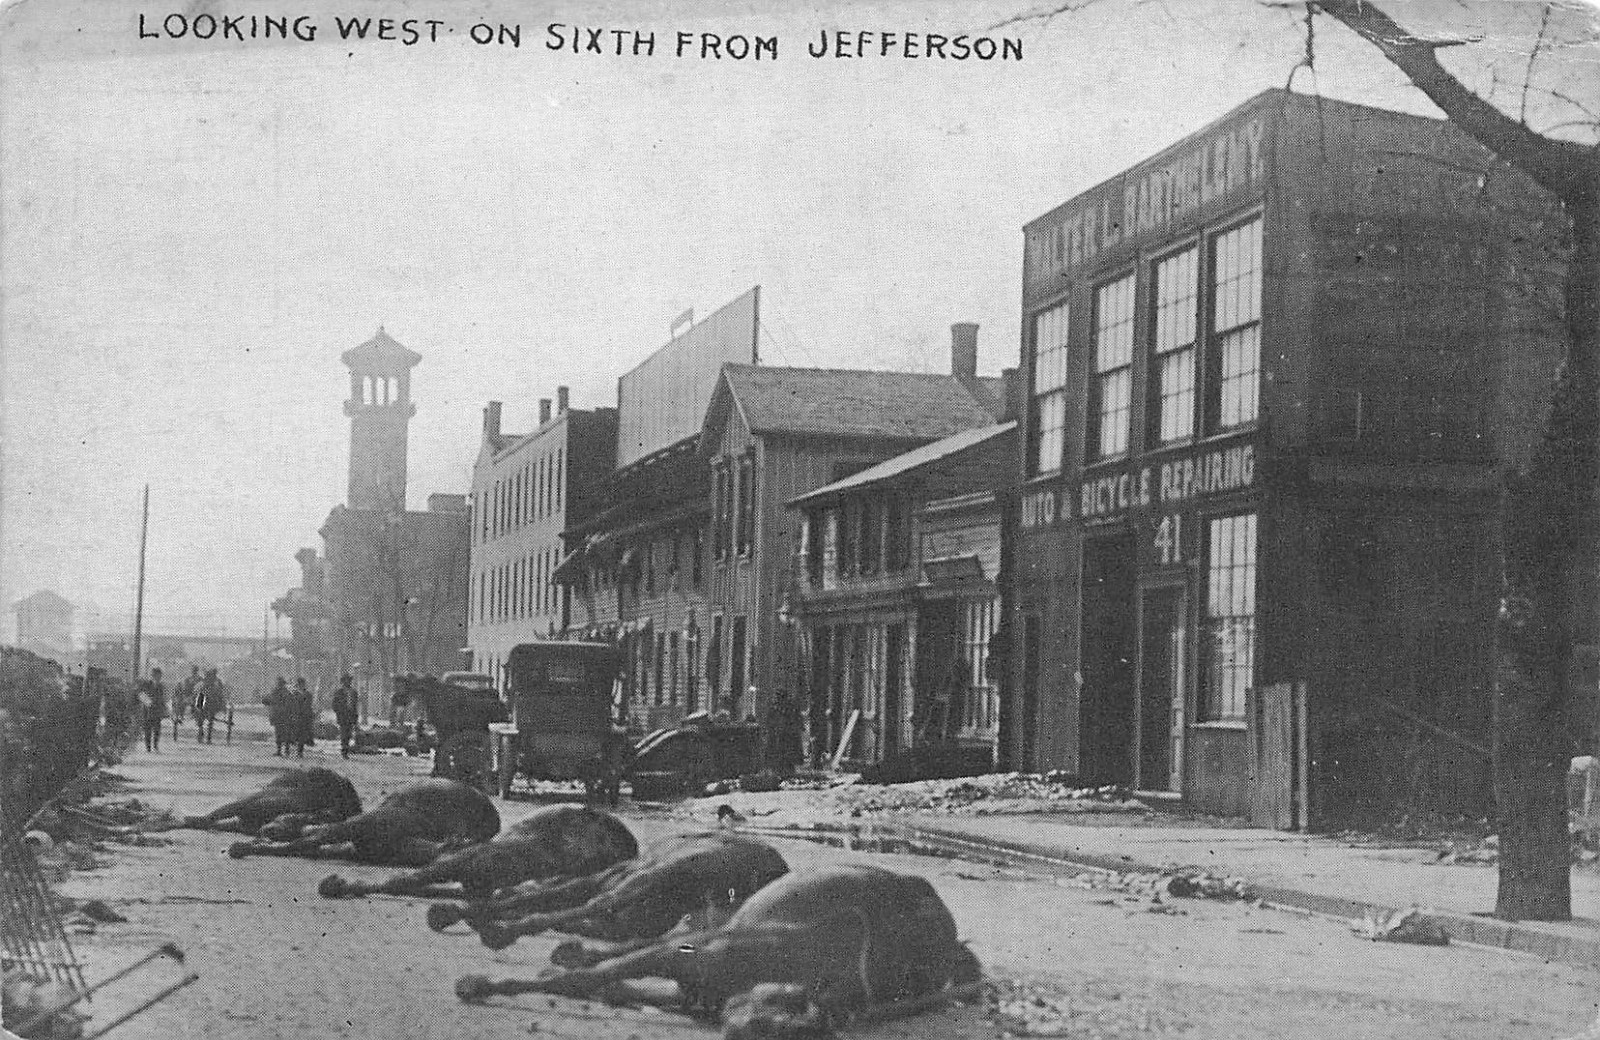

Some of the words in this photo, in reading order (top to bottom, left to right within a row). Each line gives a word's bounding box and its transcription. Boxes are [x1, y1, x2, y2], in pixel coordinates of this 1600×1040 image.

[1021, 492, 1054, 527] AUTO
[1081, 467, 1151, 517] BICYCLE
[1161, 444, 1255, 502] REPAIRING
[1153, 513, 1181, 563] 41
